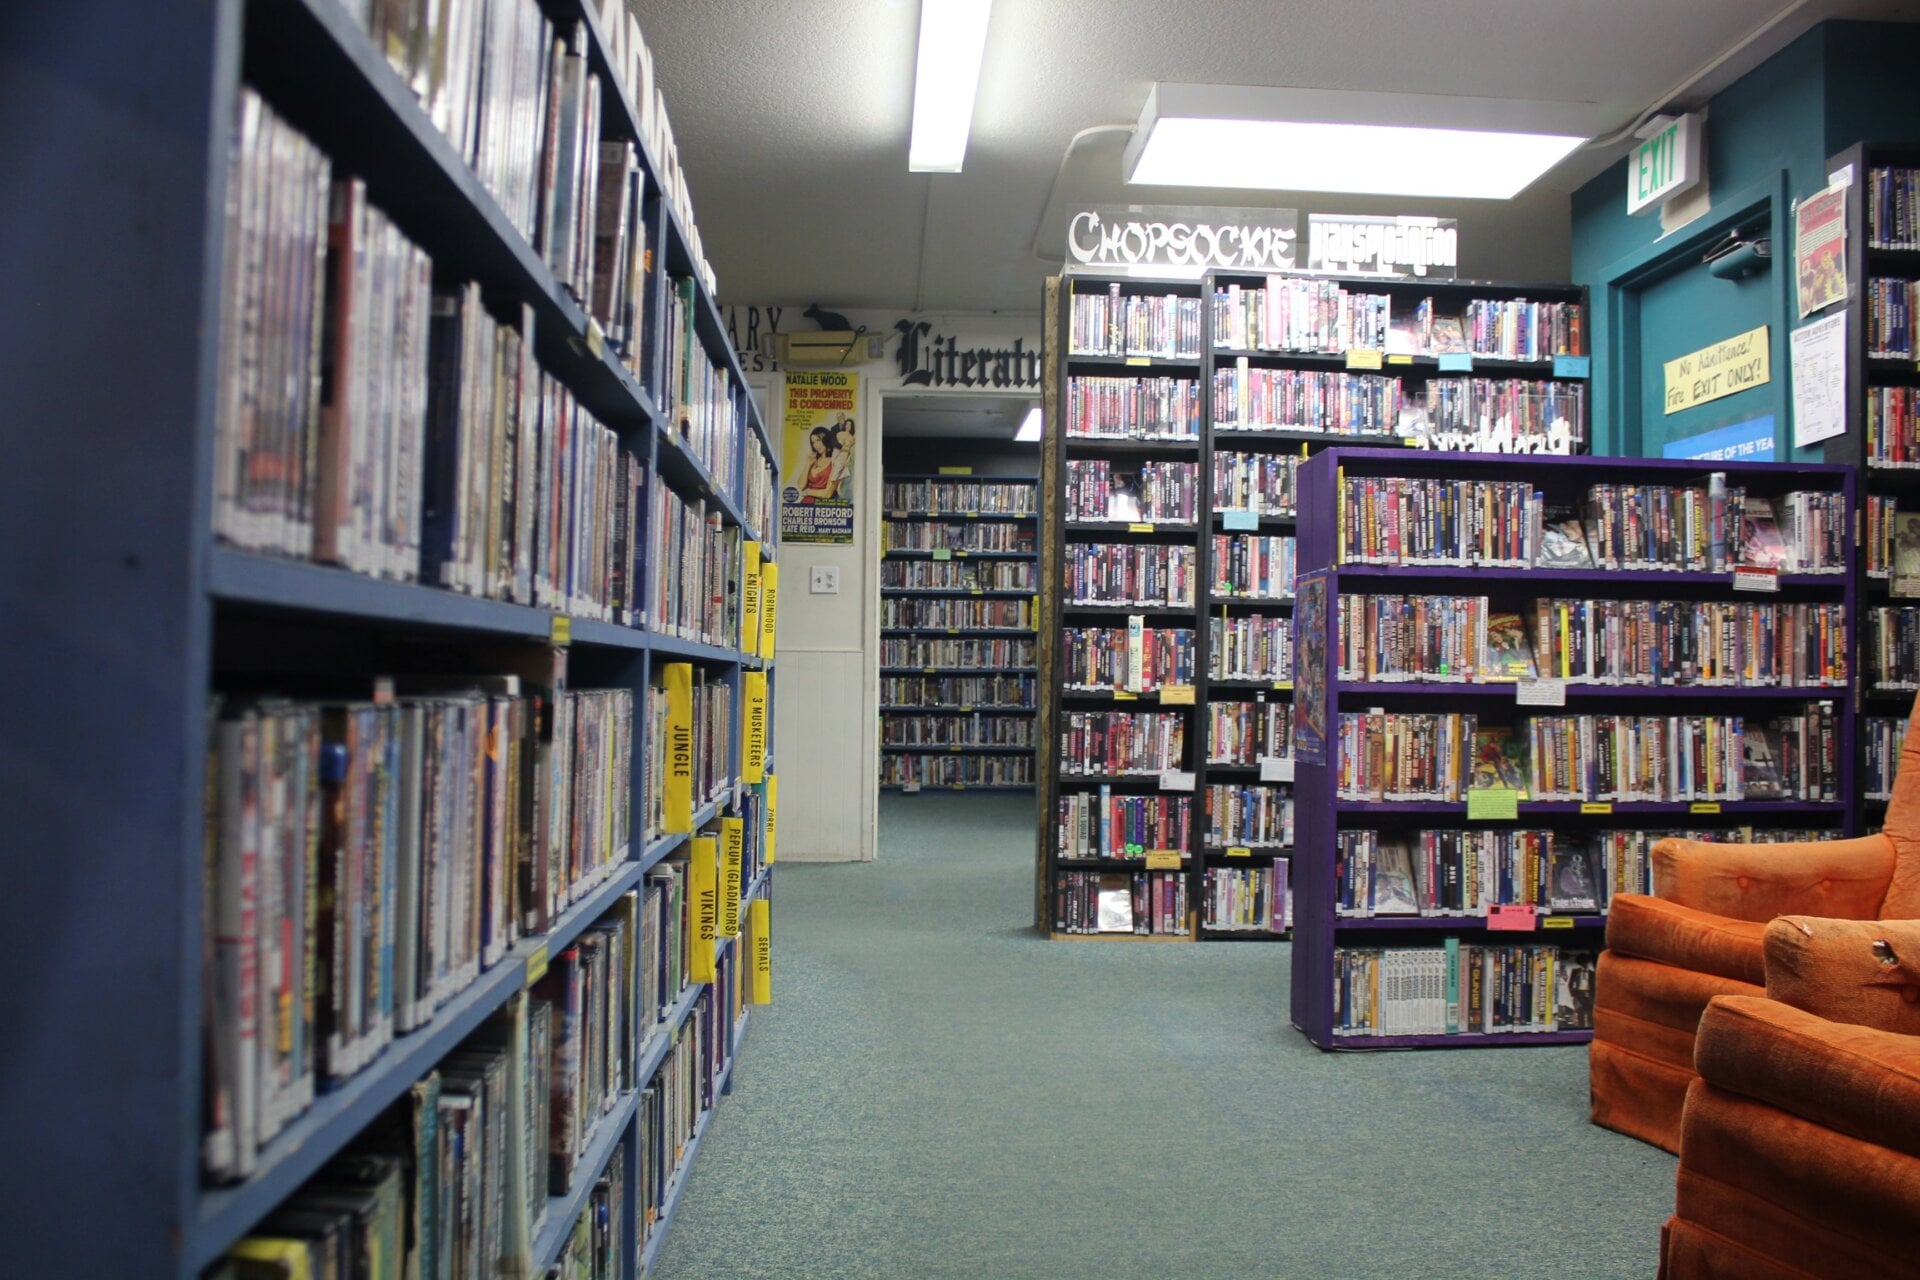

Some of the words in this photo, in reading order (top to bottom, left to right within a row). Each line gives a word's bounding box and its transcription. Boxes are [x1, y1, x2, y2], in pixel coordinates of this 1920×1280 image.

[1639, 124, 1678, 201] EXIT
[1069, 211, 1297, 269] CHOPSOCKIE
[717, 305, 782, 351] ARY
[786, 376, 818, 385] NATALIE
[821, 377, 847, 385] WOOD
[789, 388, 808, 398] THIS
[811, 389, 853, 399] PROPERTY
[1693, 373, 1722, 401] EXIT
[1728, 357, 1762, 388] ONLY!
[790, 400, 798, 409] IS
[1724, 446, 1737, 459] OF
[1738, 441, 1754, 456] THE
[783, 507, 814, 517] ROBERT
[815, 507, 853, 518] REDFORD
[783, 517, 813, 525] CHARLES
[814, 517, 847, 526] BRONSON
[783, 525, 798, 533] KATE
[799, 525, 815, 534] REID
[746, 573, 758, 614] KNIGHTS
[765, 589, 776, 634] ROBINHOOD
[673, 725, 689, 777] JUNGLE
[750, 707, 762, 767] MUSKETEERS
[1079, 820, 1089, 840] SQUAD
[1080, 806, 1089, 819] KILL
[1233, 798, 1241, 828] CIRCUIT
[728, 828, 741, 865] PEPLUM
[700, 890, 714, 941] VIKINGS
[725, 869, 740, 936] (GLADIATORS)
[758, 937, 769, 972] SERIALS
